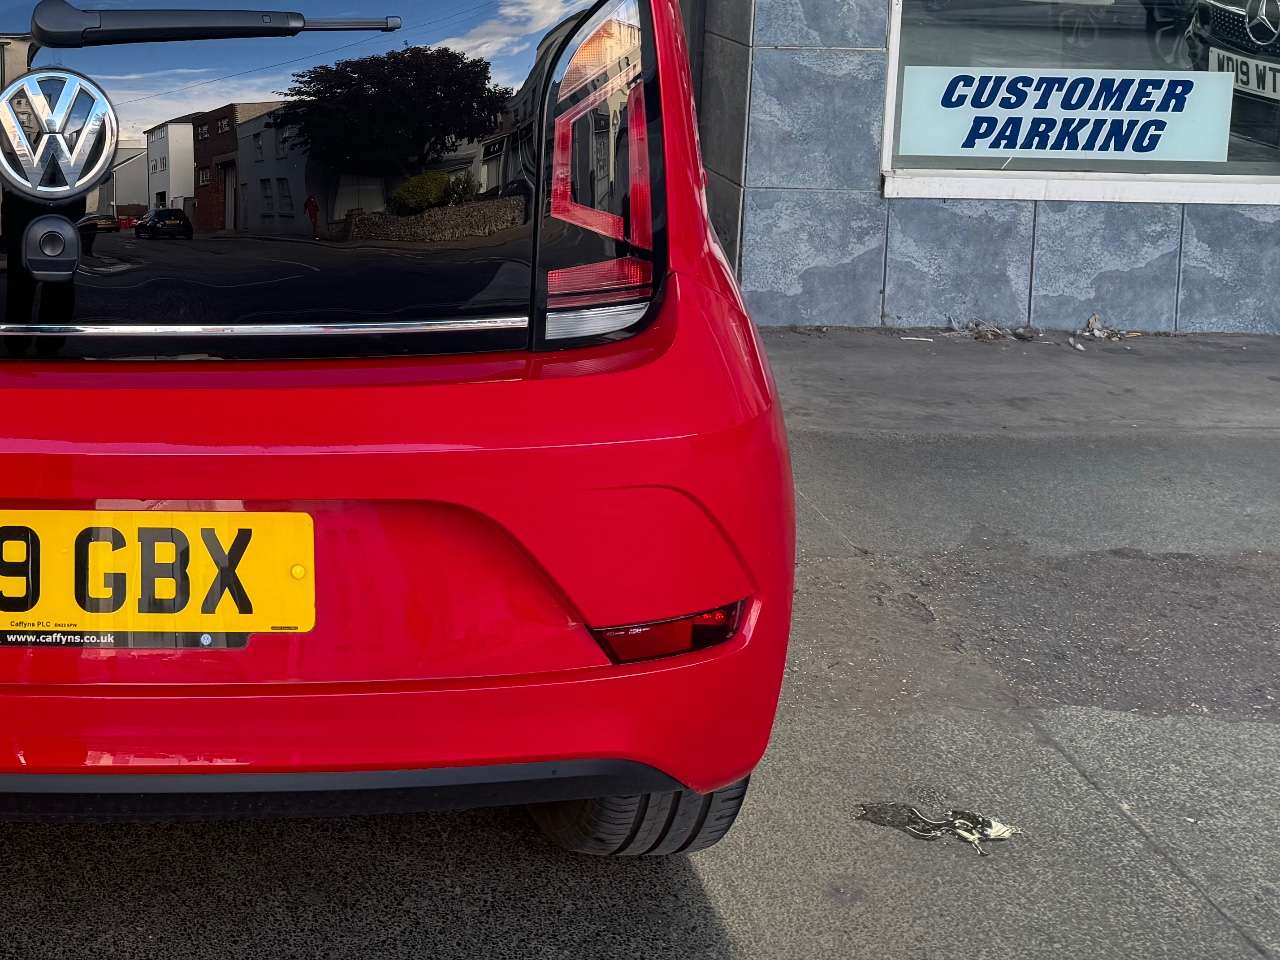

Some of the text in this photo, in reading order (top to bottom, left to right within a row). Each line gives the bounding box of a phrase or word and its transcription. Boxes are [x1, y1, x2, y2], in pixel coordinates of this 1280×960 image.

[939, 74, 1195, 113] CUSTOMER
[1255, 63, 1280, 94] WT
[960, 115, 1168, 153] PARKING
[74, 526, 254, 615] GBX
[6, 632, 115, 645] www.caffyns.co.uk
[10, 620, 35, 628] Caffyns
[36, 620, 51, 628] PLC
